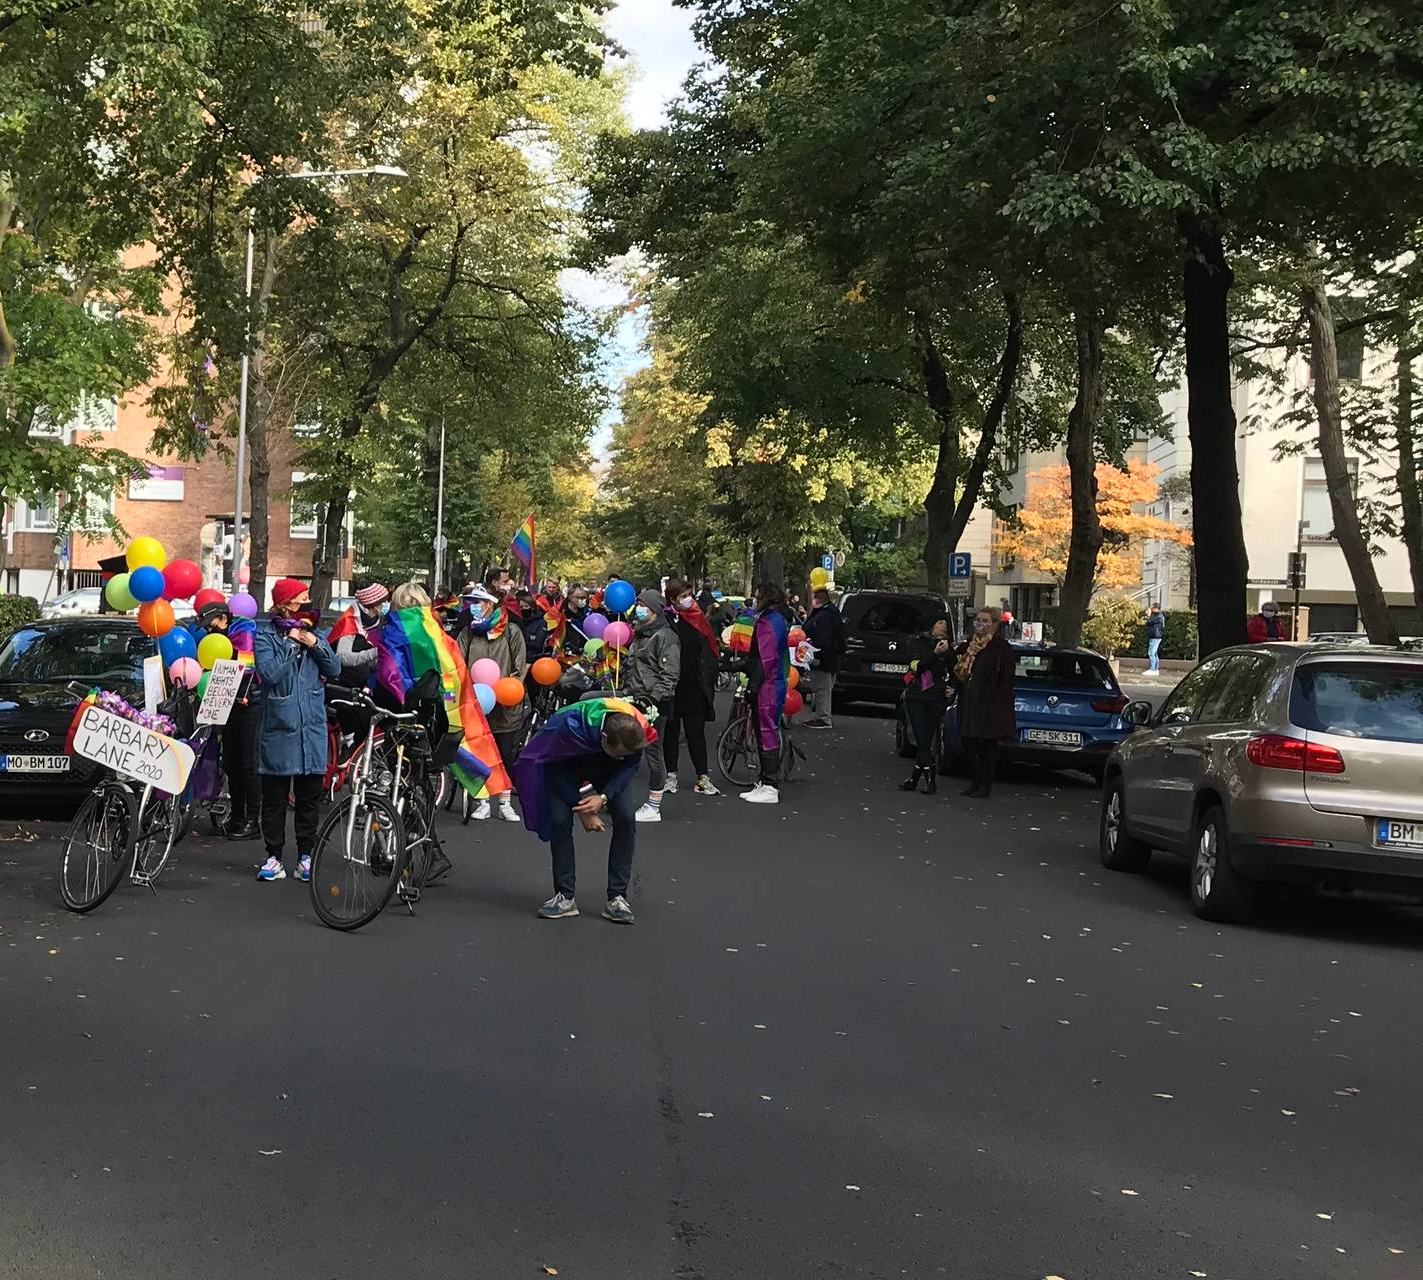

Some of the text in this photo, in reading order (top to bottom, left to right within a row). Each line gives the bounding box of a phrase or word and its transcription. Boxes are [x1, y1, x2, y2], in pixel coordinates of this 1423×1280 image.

[207, 686, 236, 698] BELONG
[83, 709, 170, 760] BARBARY
[1048, 732, 1060, 740] SK
[1062, 733, 1079, 742] 311
[7, 757, 69, 769] MO BM 107
[83, 736, 163, 781] LANE 2020
[1391, 823, 1415, 840] BM
